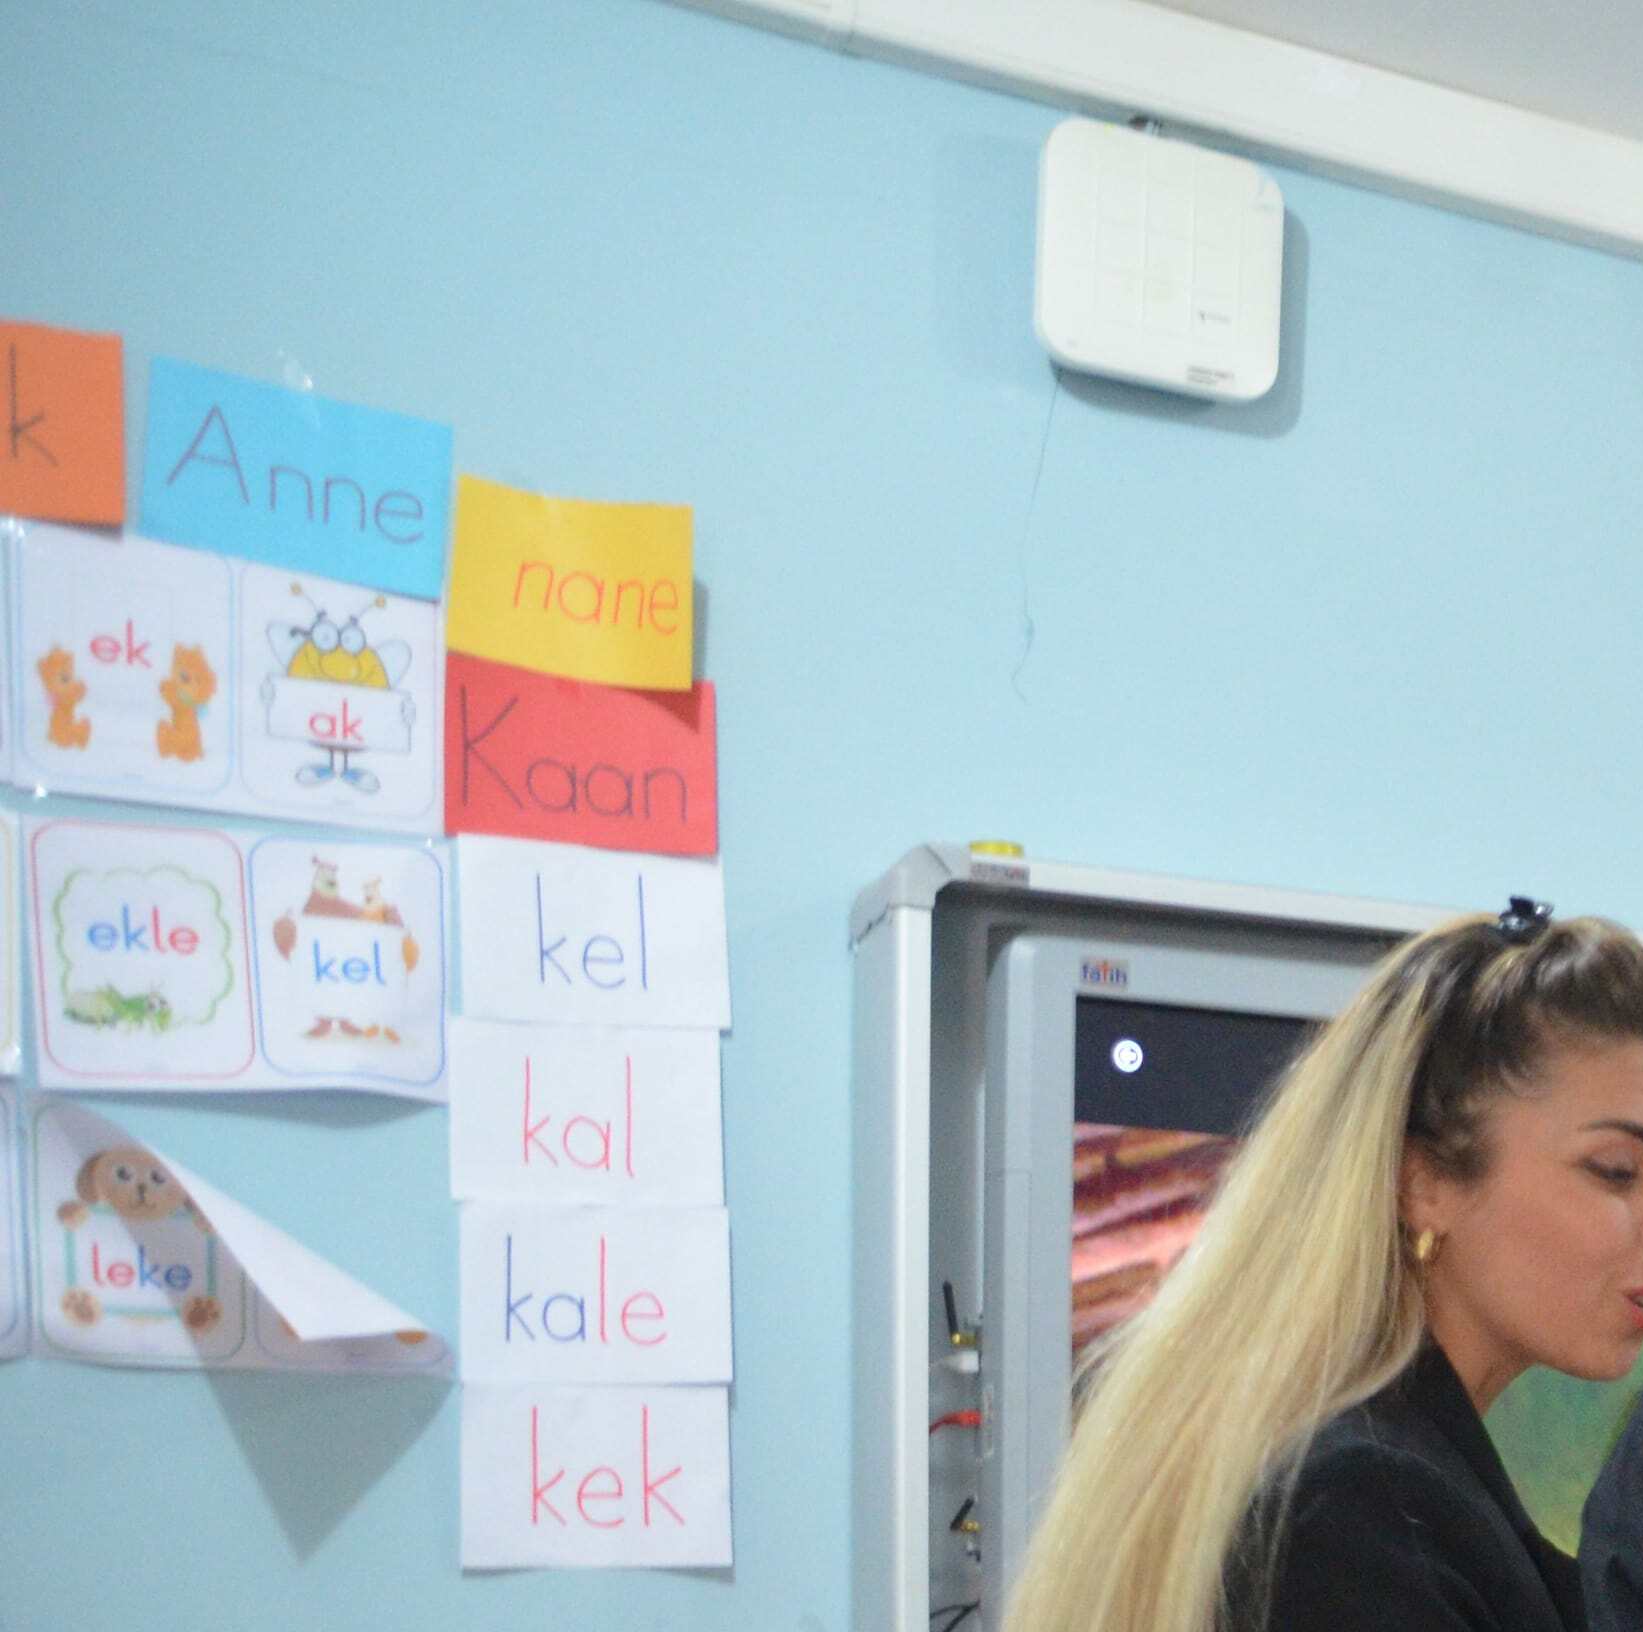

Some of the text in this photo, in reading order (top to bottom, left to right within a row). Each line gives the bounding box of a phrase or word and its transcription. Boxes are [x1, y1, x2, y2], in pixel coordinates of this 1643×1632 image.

[166, 404, 427, 546] Anne
[89, 619, 153, 669] ek
[511, 558, 681, 636] nane
[308, 698, 365, 743] ak
[457, 684, 689, 823] Kaan
[86, 904, 202, 957] ekle
[312, 939, 388, 986] kel
[536, 872, 648, 991] kel
[523, 1055, 638, 1178] kal
[91, 1242, 193, 1291] leke
[504, 1233, 669, 1347] kale
[530, 1403, 687, 1530] kek
